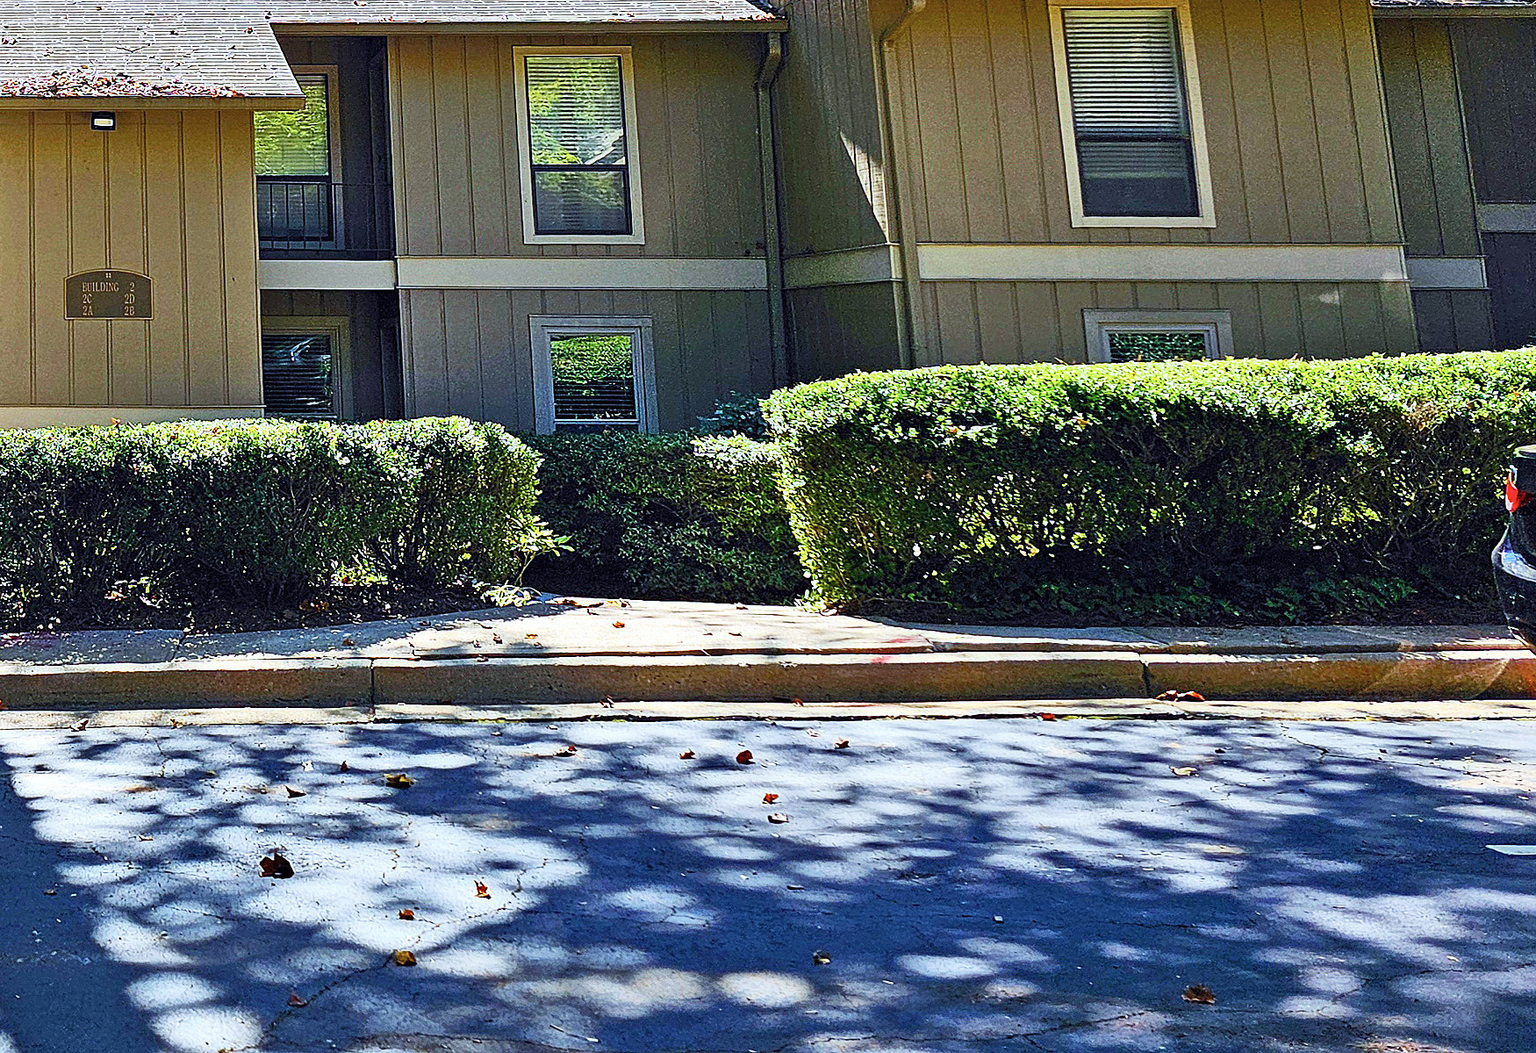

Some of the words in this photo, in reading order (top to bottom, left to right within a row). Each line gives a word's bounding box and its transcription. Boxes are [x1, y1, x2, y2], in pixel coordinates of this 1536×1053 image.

[82, 282, 119, 292] BUILDING
[129, 282, 135, 292] 2
[82, 294, 92, 303] 2C
[124, 294, 135, 303] 2D
[82, 306, 93, 316] 2A
[124, 306, 135, 316] 2B
